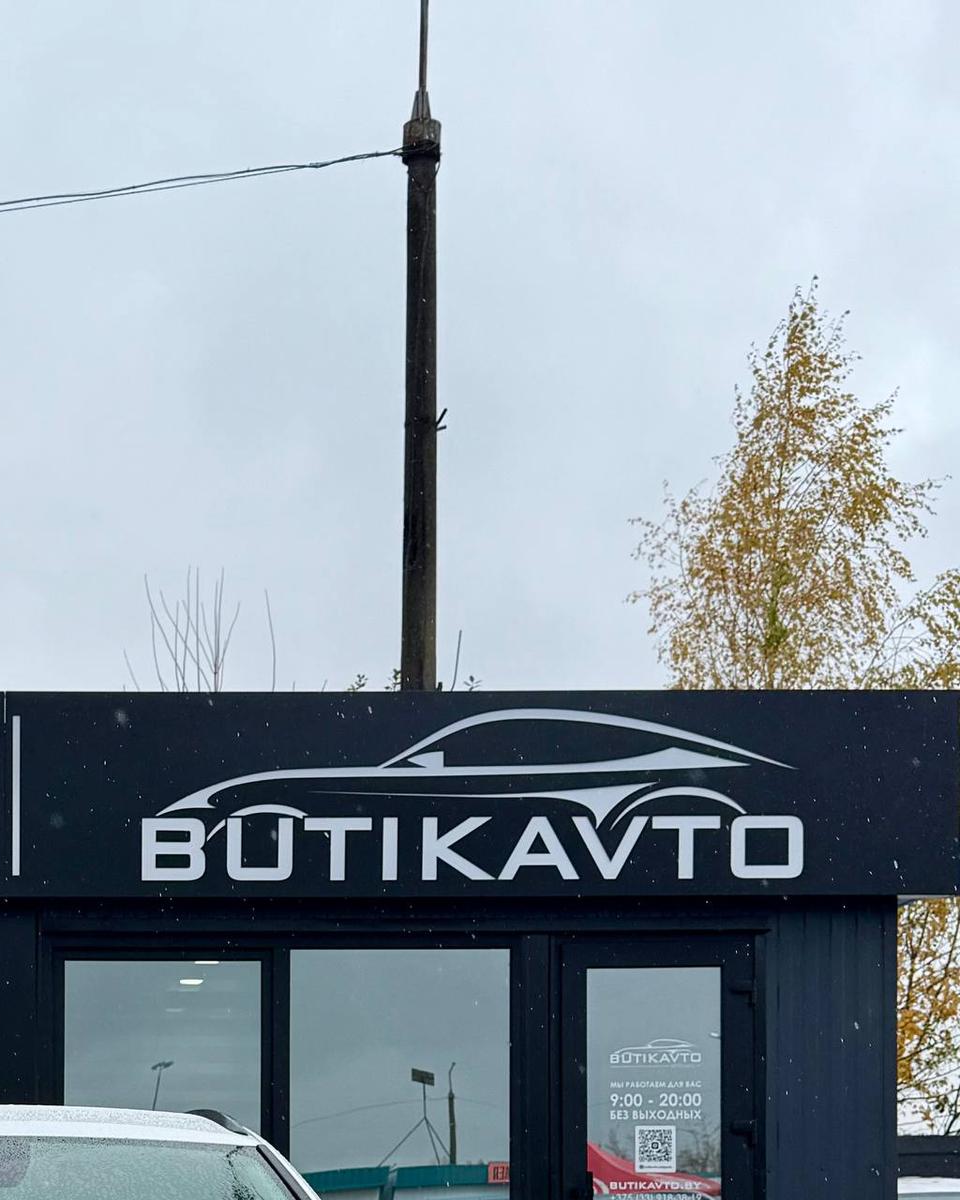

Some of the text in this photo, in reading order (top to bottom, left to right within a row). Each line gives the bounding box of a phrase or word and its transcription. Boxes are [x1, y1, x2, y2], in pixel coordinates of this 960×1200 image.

[141, 813, 805, 882] BUTIKAVTO
[610, 1053, 701, 1064] BUTIKAVTO
[685, 1080, 702, 1088] ВАС
[610, 1093, 643, 1107] 9:00
[659, 1093, 702, 1107] 20:00
[610, 1110, 702, 1120] БЕЗ ВЫХОДНЫХ
[609, 1181, 701, 1190] BUTIKAVTO.BY
